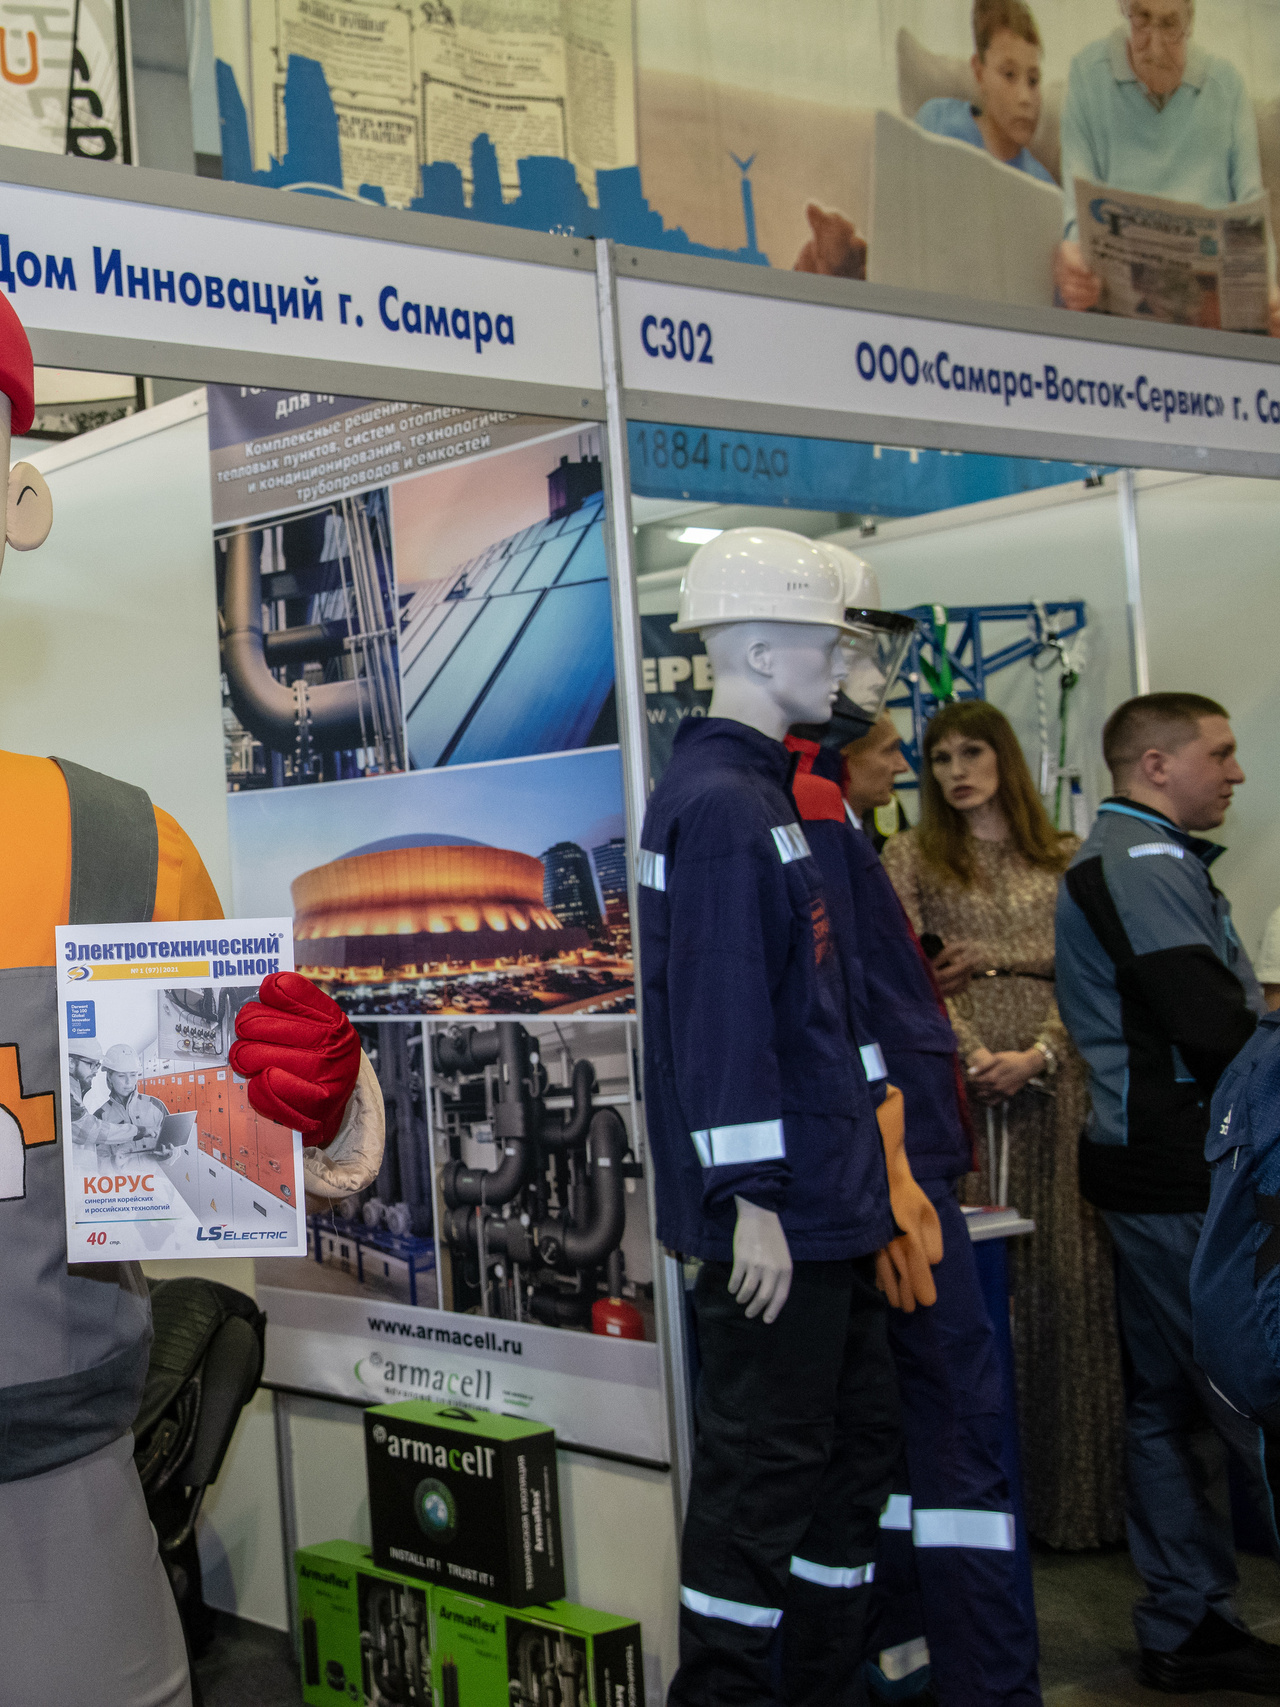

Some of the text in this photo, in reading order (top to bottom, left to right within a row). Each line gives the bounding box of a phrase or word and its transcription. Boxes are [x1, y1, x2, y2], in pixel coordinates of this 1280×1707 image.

[93, 246, 323, 325] Инноваций
[339, 293, 363, 328] г.
[378, 286, 515, 354] Самара
[640, 314, 714, 364] С302
[275, 393, 310, 419] для
[1233, 397, 1248, 422] г.
[245, 403, 407, 457] Комплексные решения
[217, 459, 280, 483] тепловых
[283, 443, 341, 469] пунктов,
[344, 425, 396, 449] систем
[296, 431, 491, 501] трубопроводов и ёмкостей
[636, 429, 788, 478] 1884 года
[247, 481, 256, 494] и
[65, 933, 279, 961] Электротехнический
[213, 958, 280, 979] рынок
[84, 1174, 154, 1194] КОРУС
[85, 1197, 116, 1205] синергия
[91, 1206, 130, 1214] российских
[131, 1204, 170, 1212] технологий
[87, 1232, 107, 1246] 40
[368, 1316, 522, 1356] www.armacell.ru
[384, 1360, 491, 1401] armacell
[387, 1435, 496, 1480] armacell
[440, 1605, 497, 1634] Armaflex
